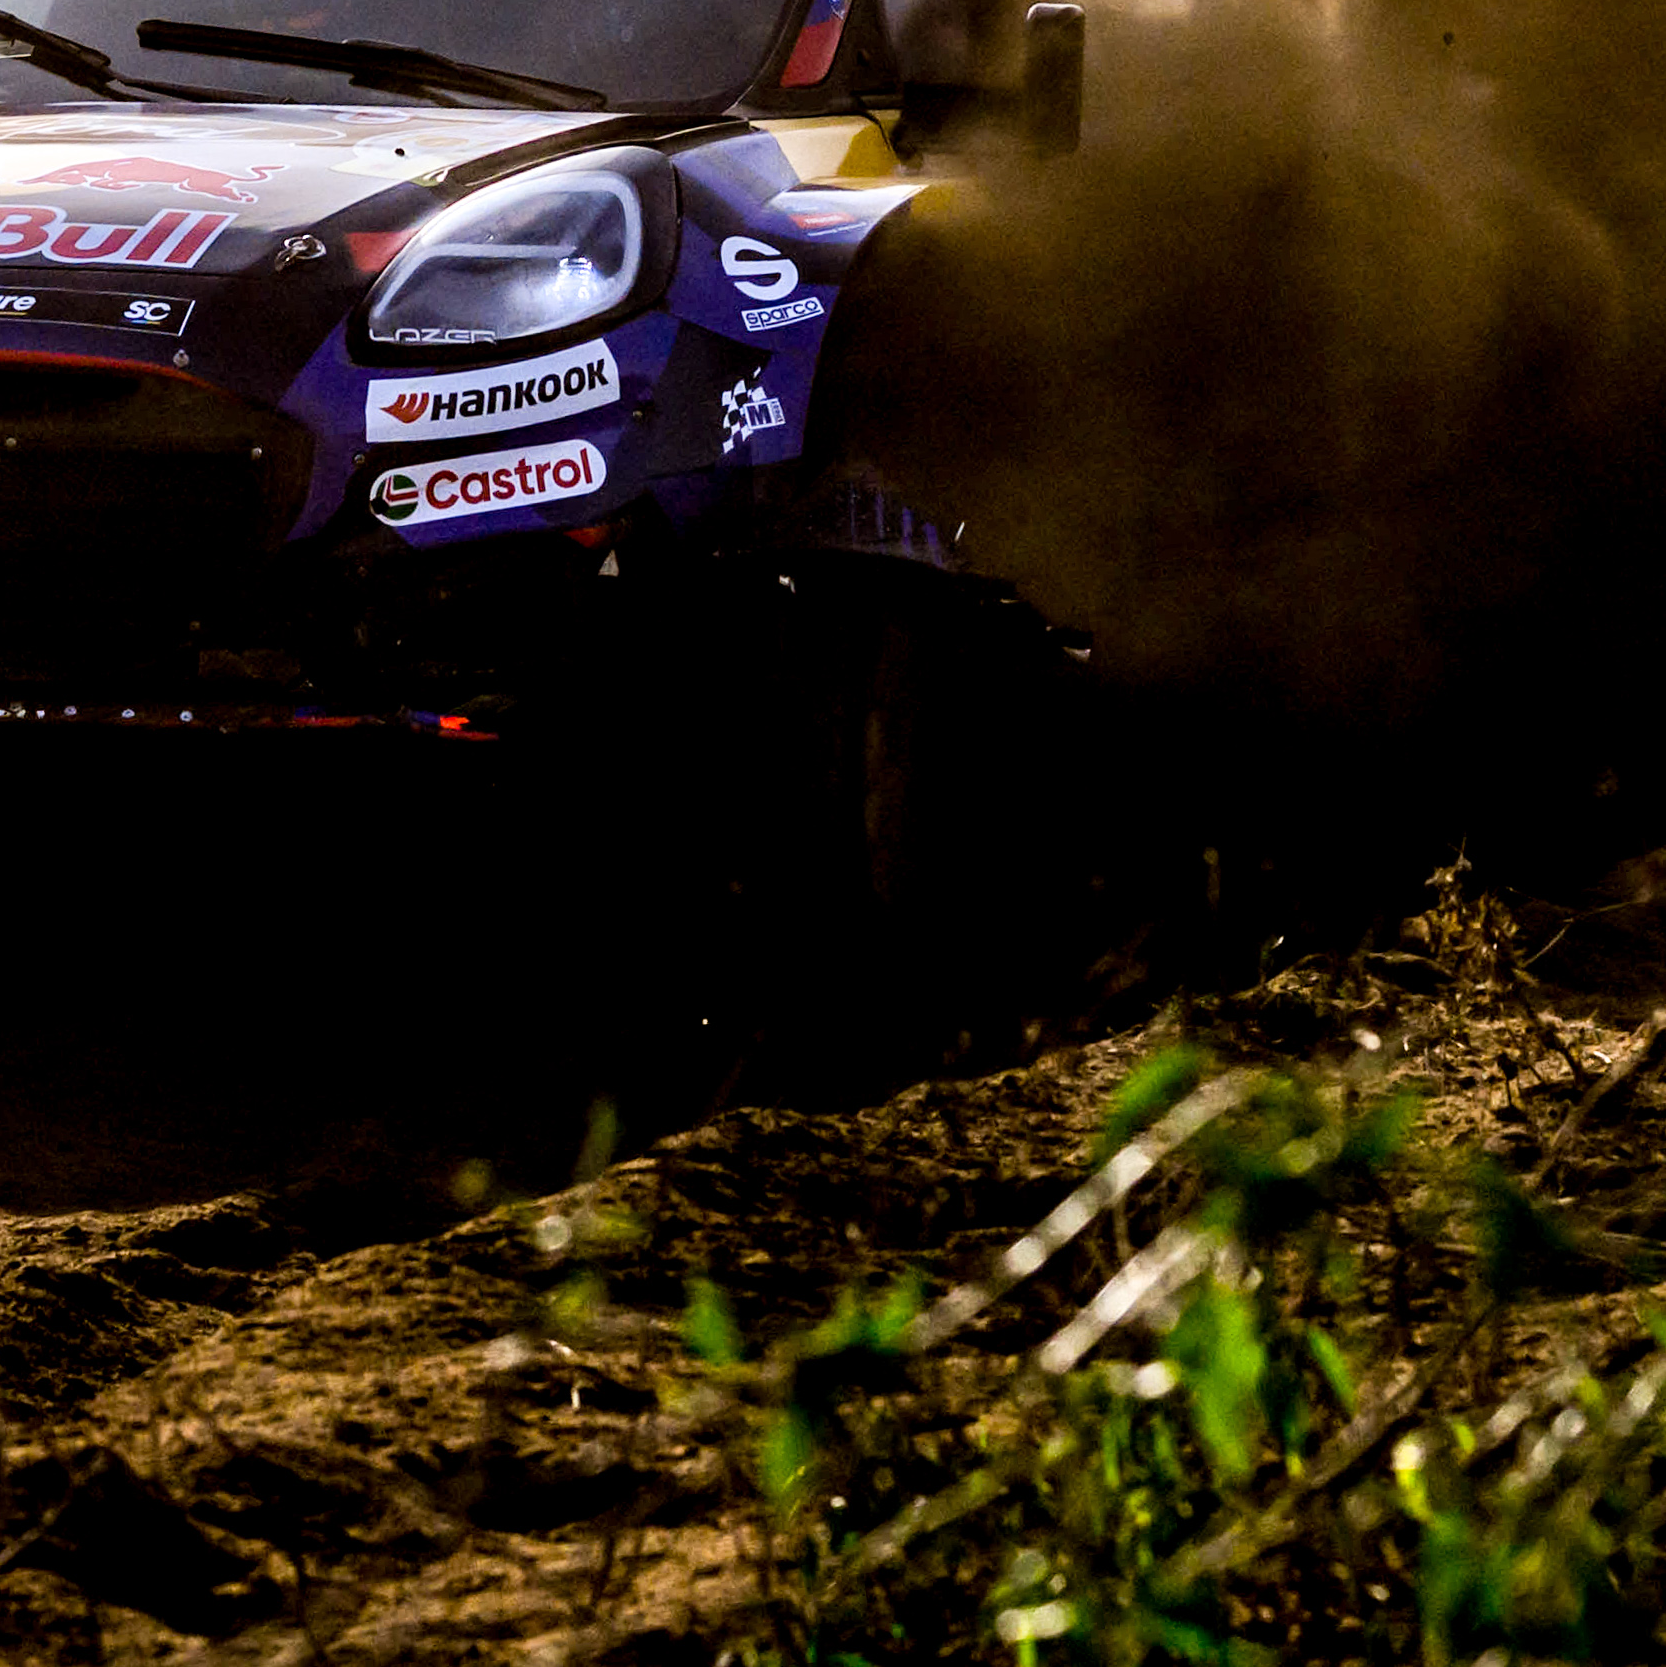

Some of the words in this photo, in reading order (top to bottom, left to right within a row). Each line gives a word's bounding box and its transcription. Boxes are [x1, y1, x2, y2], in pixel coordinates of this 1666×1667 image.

[123, 300, 171, 322] SC
[745, 299, 819, 327] sparco
[425, 447, 593, 510] Castrol
